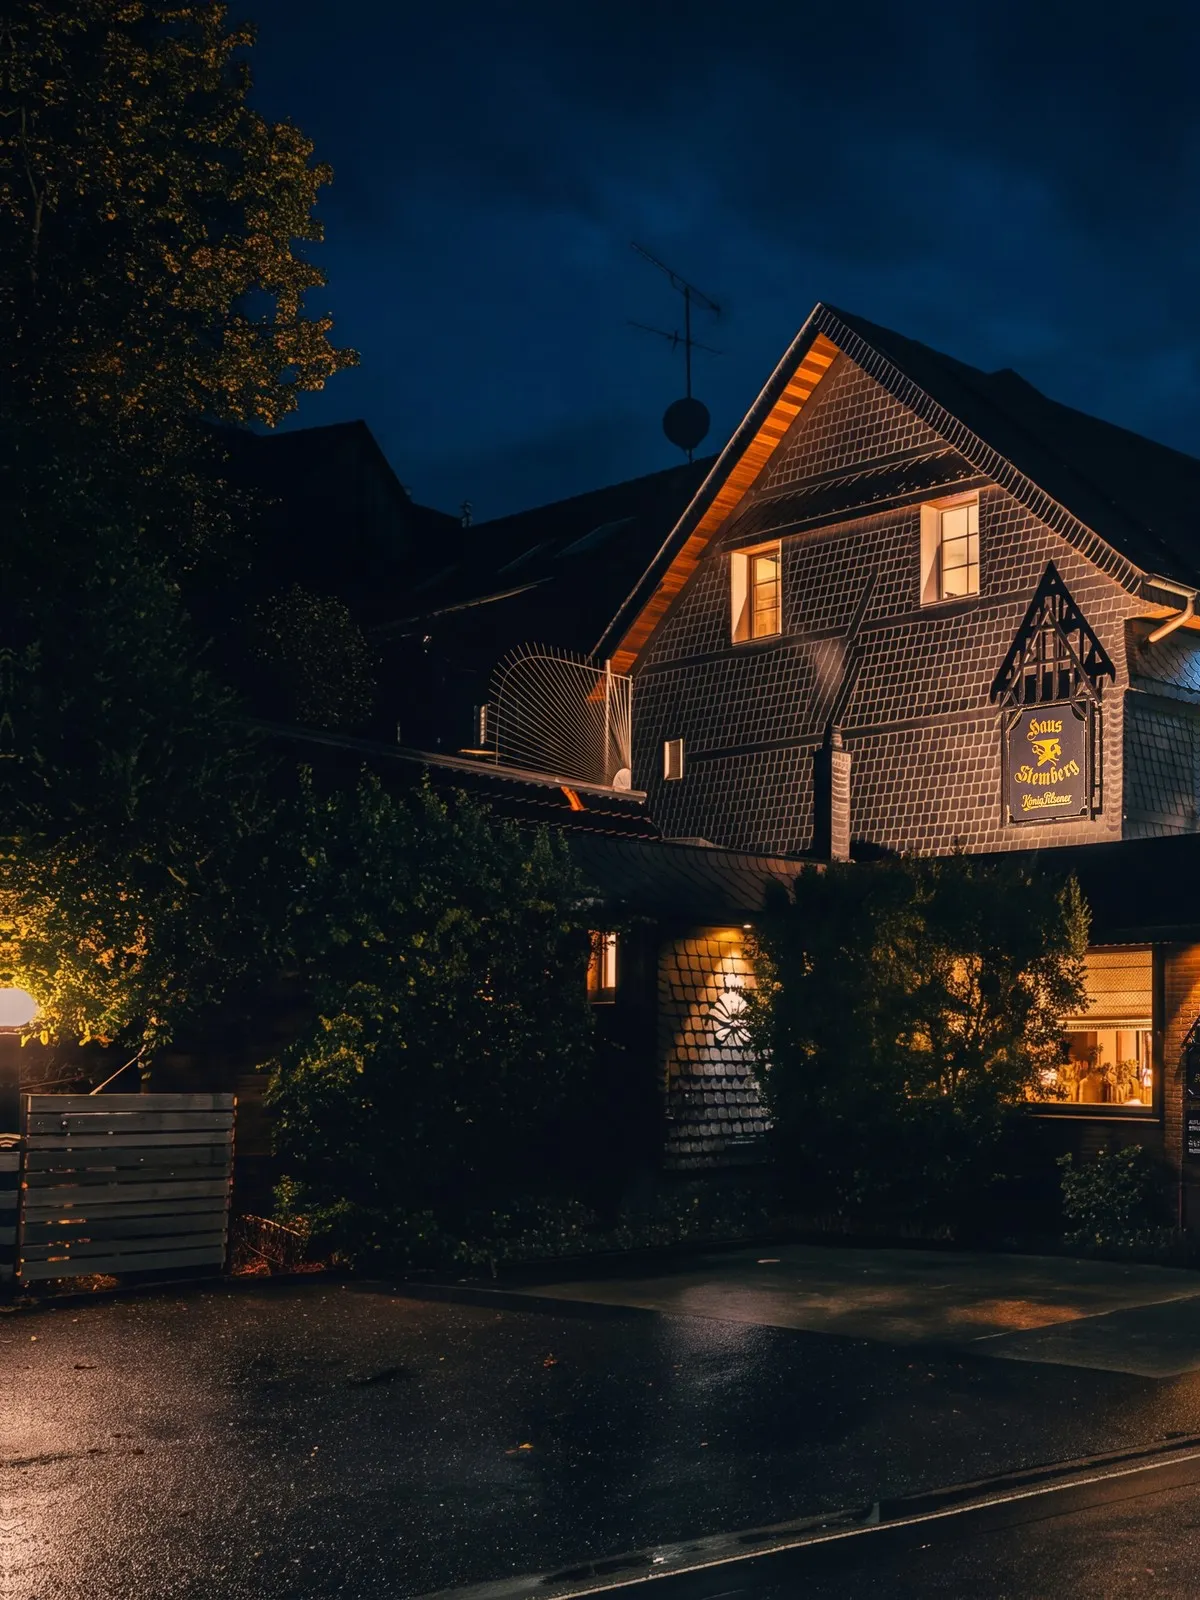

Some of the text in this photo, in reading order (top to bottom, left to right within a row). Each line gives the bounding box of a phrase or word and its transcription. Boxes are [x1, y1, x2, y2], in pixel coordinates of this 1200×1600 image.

[1027, 718, 1063, 740] Haus
[1014, 759, 1080, 785] Stemberg
[1021, 791, 1072, 808] König Pilsener
